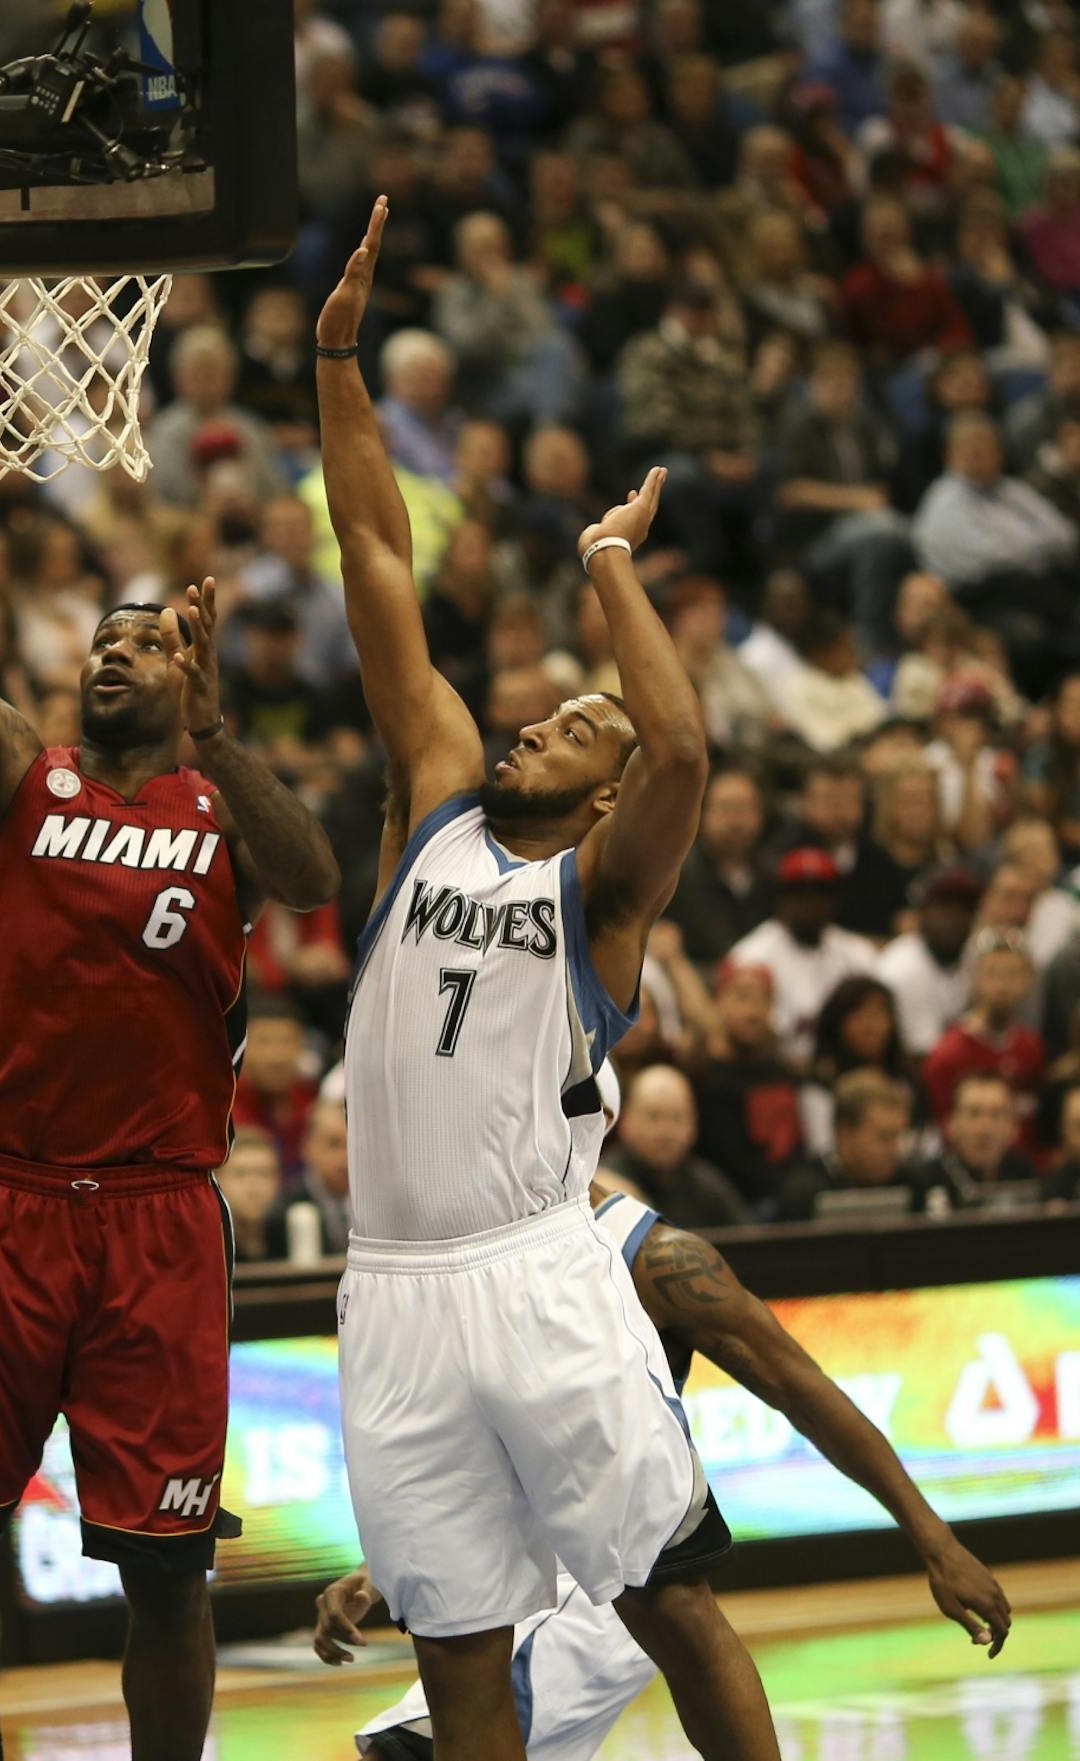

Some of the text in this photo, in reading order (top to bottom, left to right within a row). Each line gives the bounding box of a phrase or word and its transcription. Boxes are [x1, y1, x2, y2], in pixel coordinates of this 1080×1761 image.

[147, 74, 177, 102] NBA
[30, 813, 221, 877] MIAMI
[141, 885, 197, 950] 6
[401, 878, 558, 960] WOLVES
[435, 967, 478, 1057] 7
